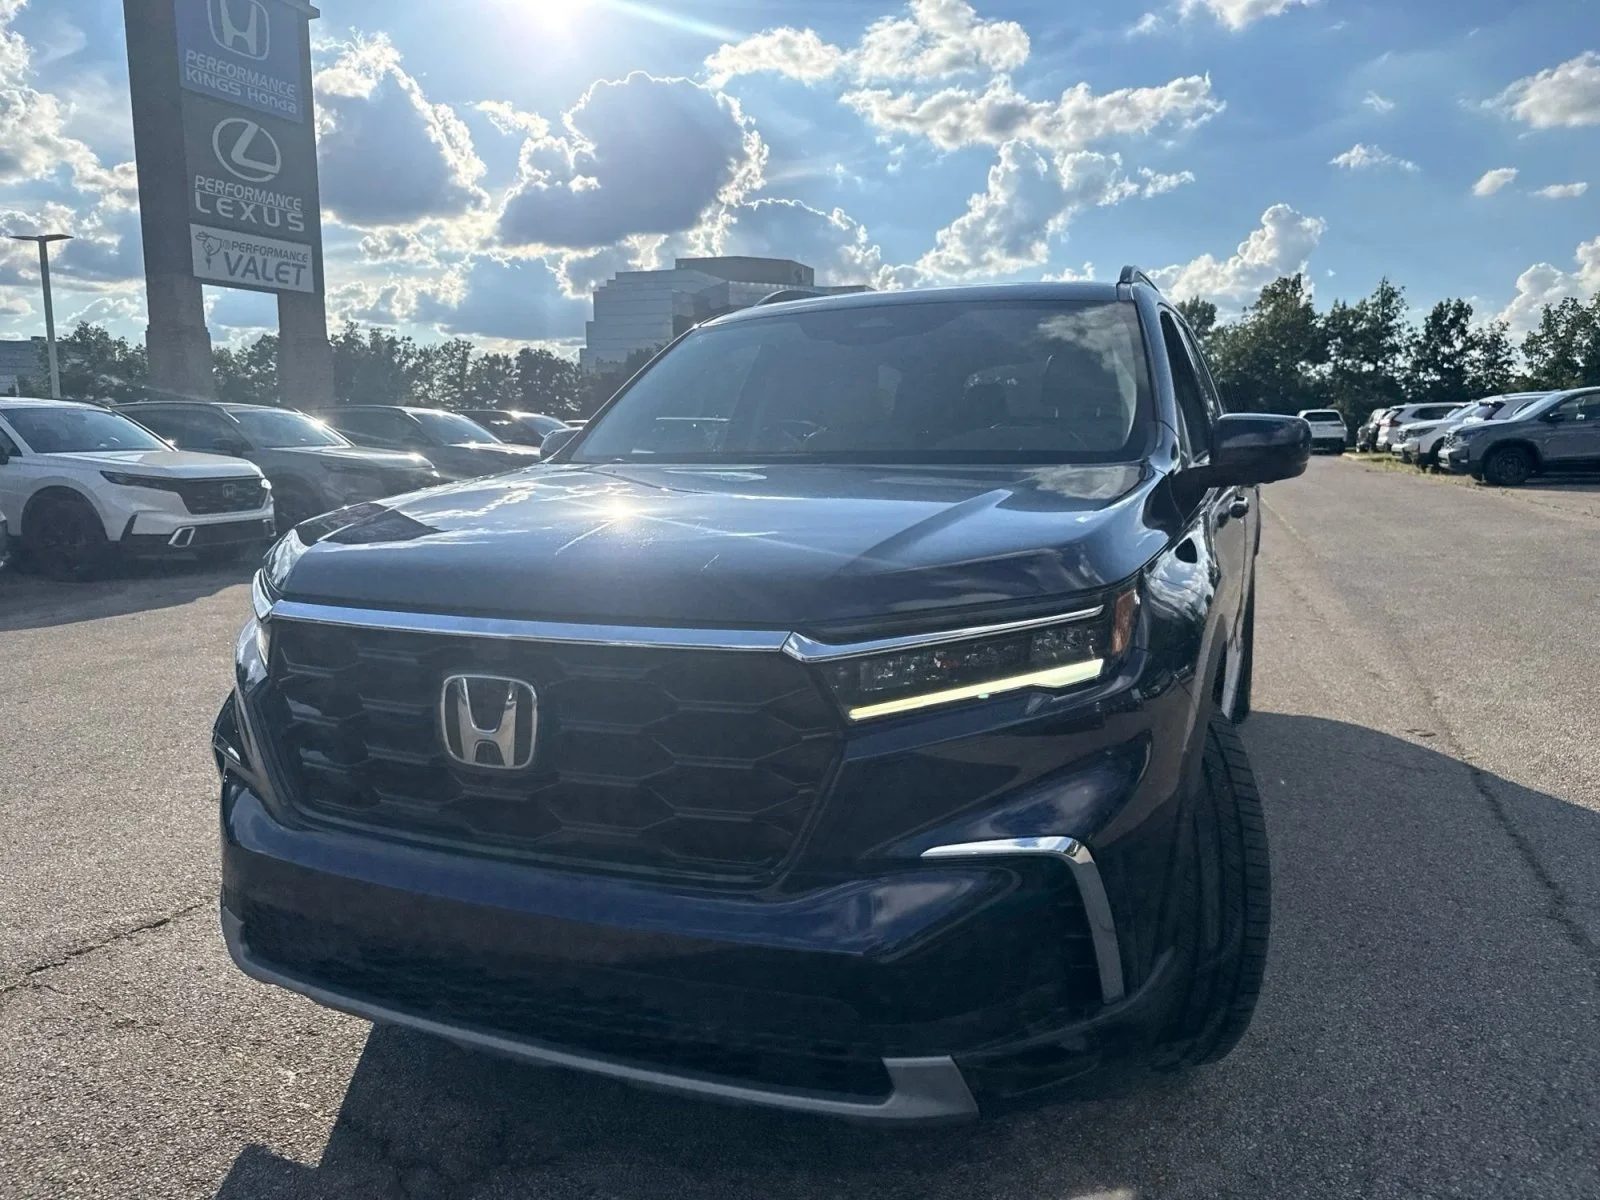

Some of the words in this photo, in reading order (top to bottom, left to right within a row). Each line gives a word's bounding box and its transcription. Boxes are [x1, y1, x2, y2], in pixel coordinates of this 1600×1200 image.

[185, 49, 296, 98] PERFORMANCE
[186, 67, 241, 97] KINGS
[247, 86, 298, 115] Honda
[194, 175, 302, 210] PERFORMANCE
[195, 190, 304, 232] LEXUS
[223, 251, 306, 286] VALET
[231, 240, 309, 263] PERFORMANCE
